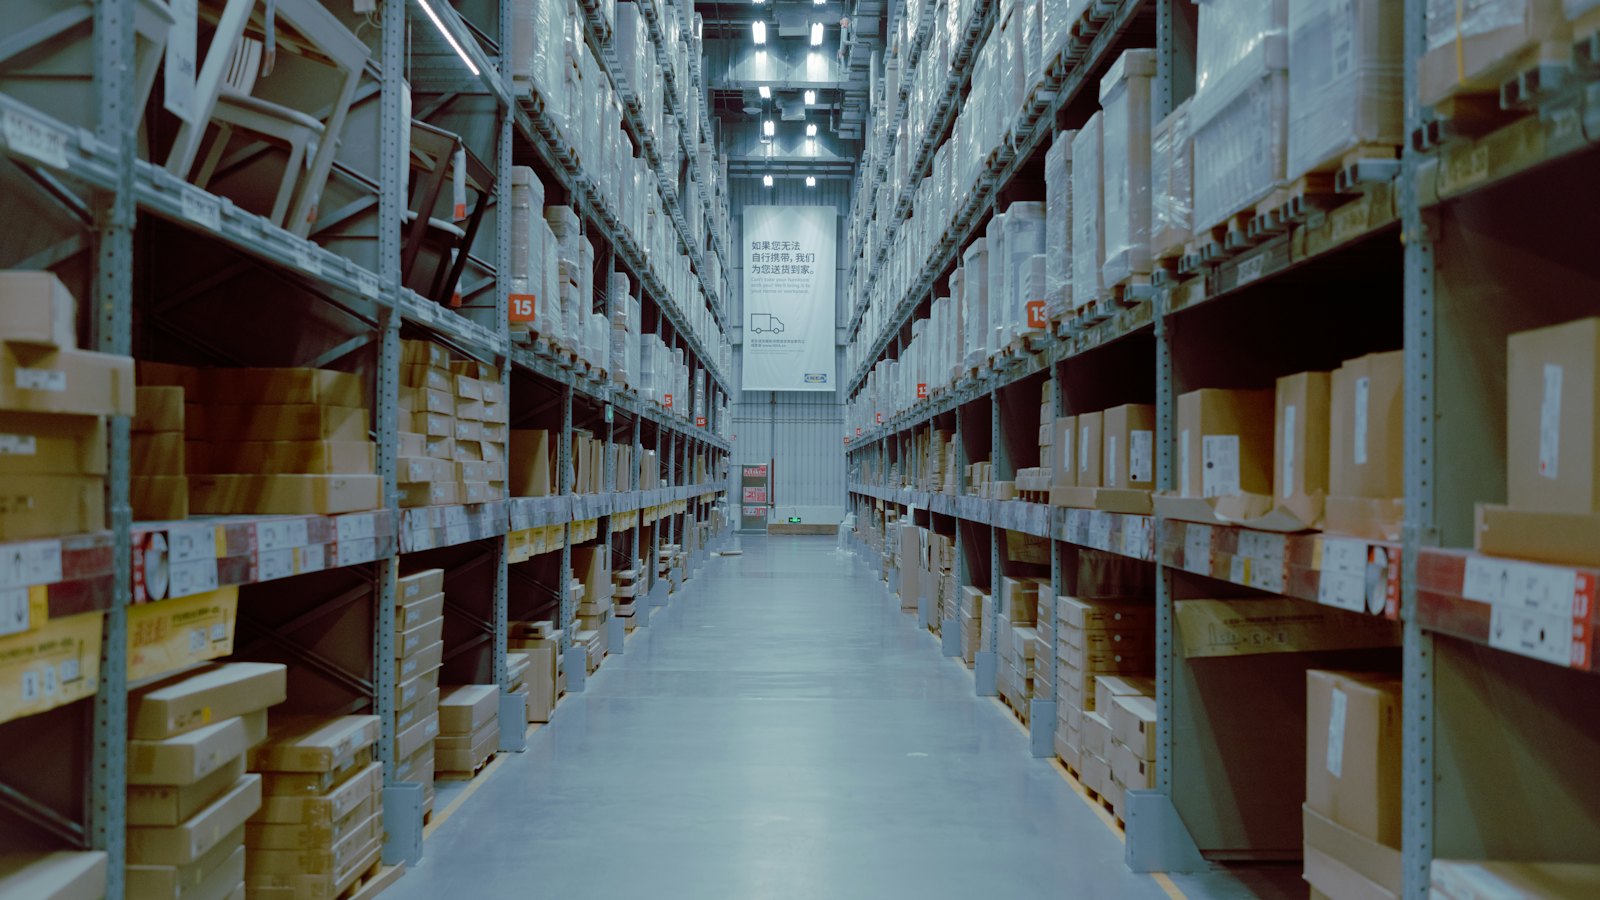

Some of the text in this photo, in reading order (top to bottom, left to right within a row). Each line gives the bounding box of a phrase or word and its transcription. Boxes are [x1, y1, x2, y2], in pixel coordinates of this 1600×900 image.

[752, 241, 801, 251] 如果您无法
[752, 265, 814, 274] 为您送货到家。
[514, 300, 532, 316] 15
